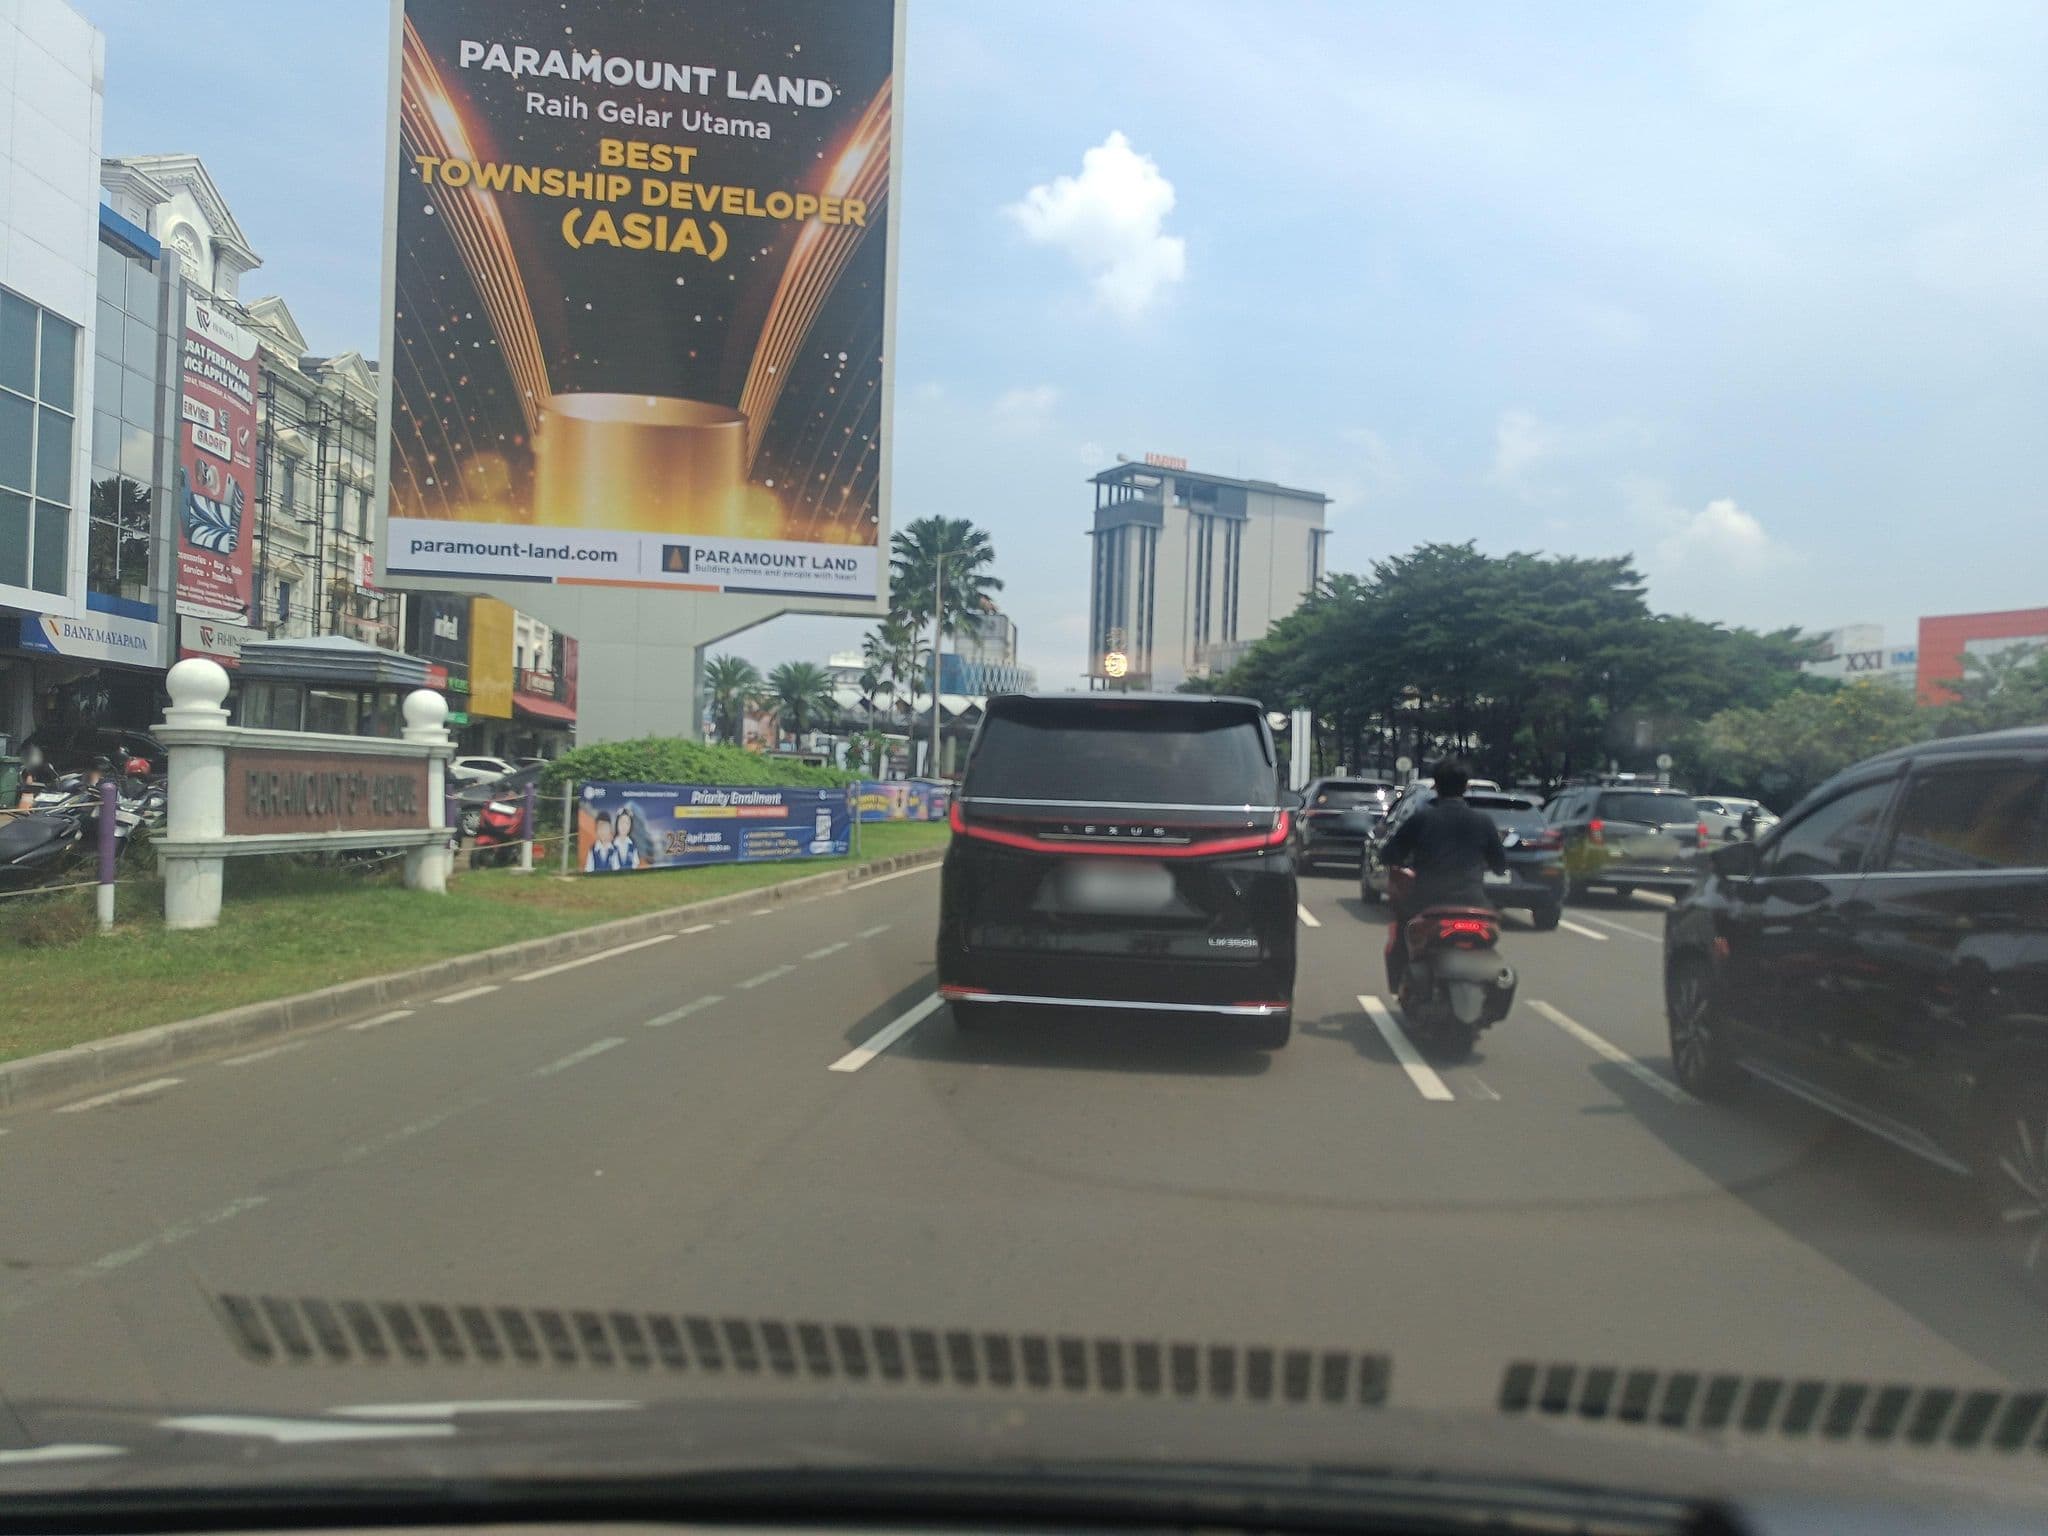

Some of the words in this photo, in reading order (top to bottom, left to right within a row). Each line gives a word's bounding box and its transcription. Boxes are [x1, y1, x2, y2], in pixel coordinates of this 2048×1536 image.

[459, 39, 717, 96] PARAMOUNT
[727, 70, 834, 109] LAND
[526, 92, 589, 121] Raih
[597, 100, 674, 129] Gelar
[681, 108, 772, 140] Utama
[600, 137, 697, 175] BEST
[415, 155, 632, 203] TOWNSHIP
[641, 178, 867, 228] DEVELOPER
[561, 206, 729, 263] (ASIA)
[204, 364, 228, 388] APPLE
[411, 538, 617, 564] paramount-land.com
[695, 549, 808, 571] PARAMOUNT
[811, 555, 859, 573] LAND
[695, 564, 731, 575] Building
[63, 623, 95, 641] BANK
[96, 629, 148, 651] MAYAPADA
[217, 631, 251, 648] RHIN
[246, 769, 344, 816] PARAMOUNT
[691, 789, 730, 806] Priority
[730, 790, 782, 805] Enrollment
